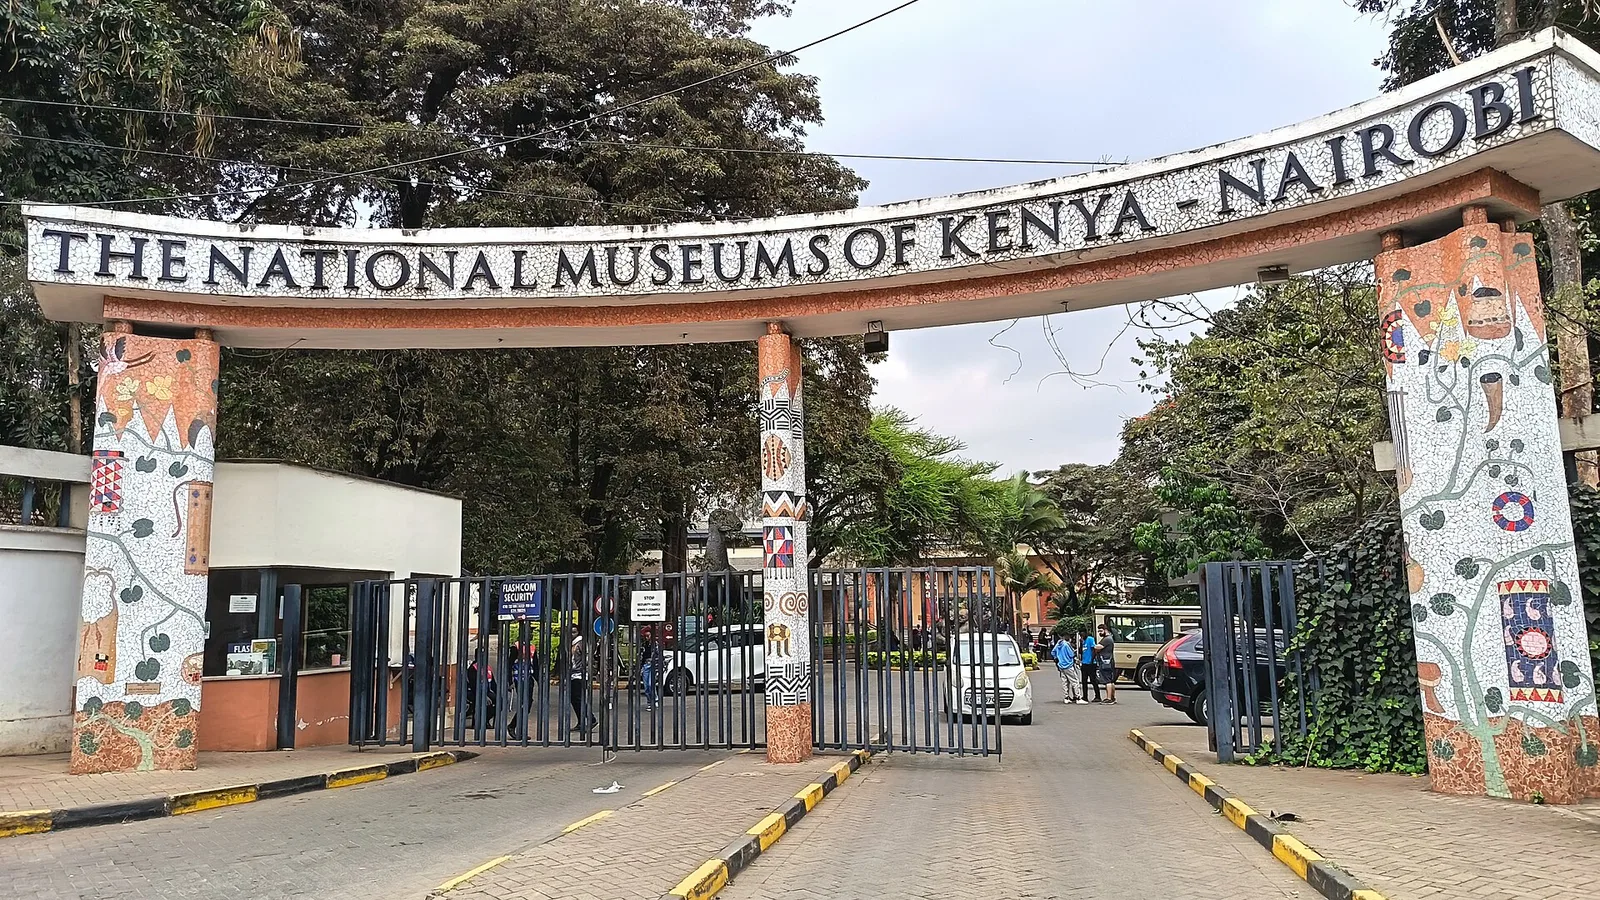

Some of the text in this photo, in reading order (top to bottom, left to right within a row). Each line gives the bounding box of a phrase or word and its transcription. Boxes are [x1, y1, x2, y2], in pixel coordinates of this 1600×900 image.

[43, 65, 1542, 291] THE NATIONAL MUSEUMS OF KENYA - NAIROBI
[502, 582, 537, 593] FLASHCOM
[503, 592, 534, 602] SECURITY
